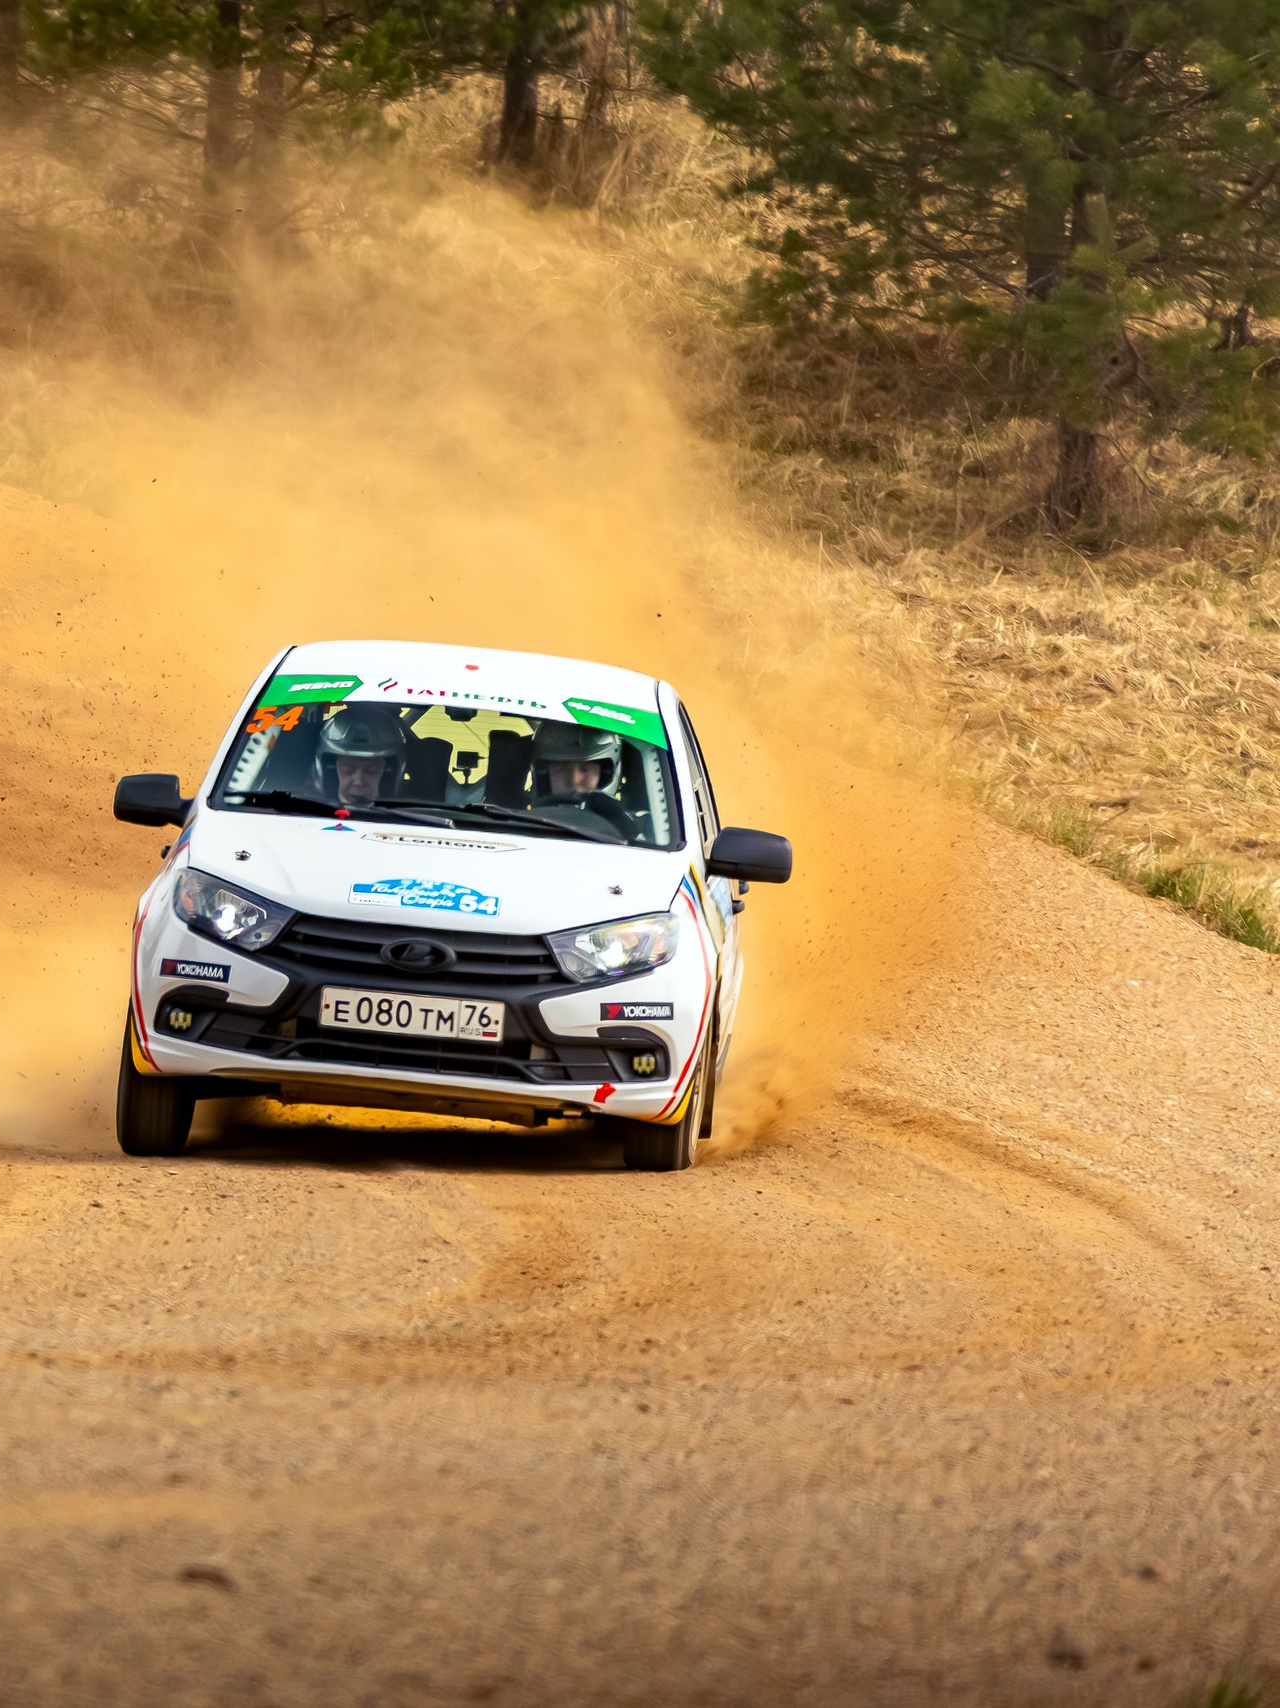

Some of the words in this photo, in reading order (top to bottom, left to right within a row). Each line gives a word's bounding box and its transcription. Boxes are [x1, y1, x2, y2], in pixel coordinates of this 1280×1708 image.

[245, 705, 305, 733] 54
[458, 894, 499, 915] 54
[176, 963, 224, 979] YOKOHAMA
[465, 1004, 492, 1028] 76
[623, 1005, 672, 1018] YOKOHAMA
[459, 1026, 482, 1037] RUS
